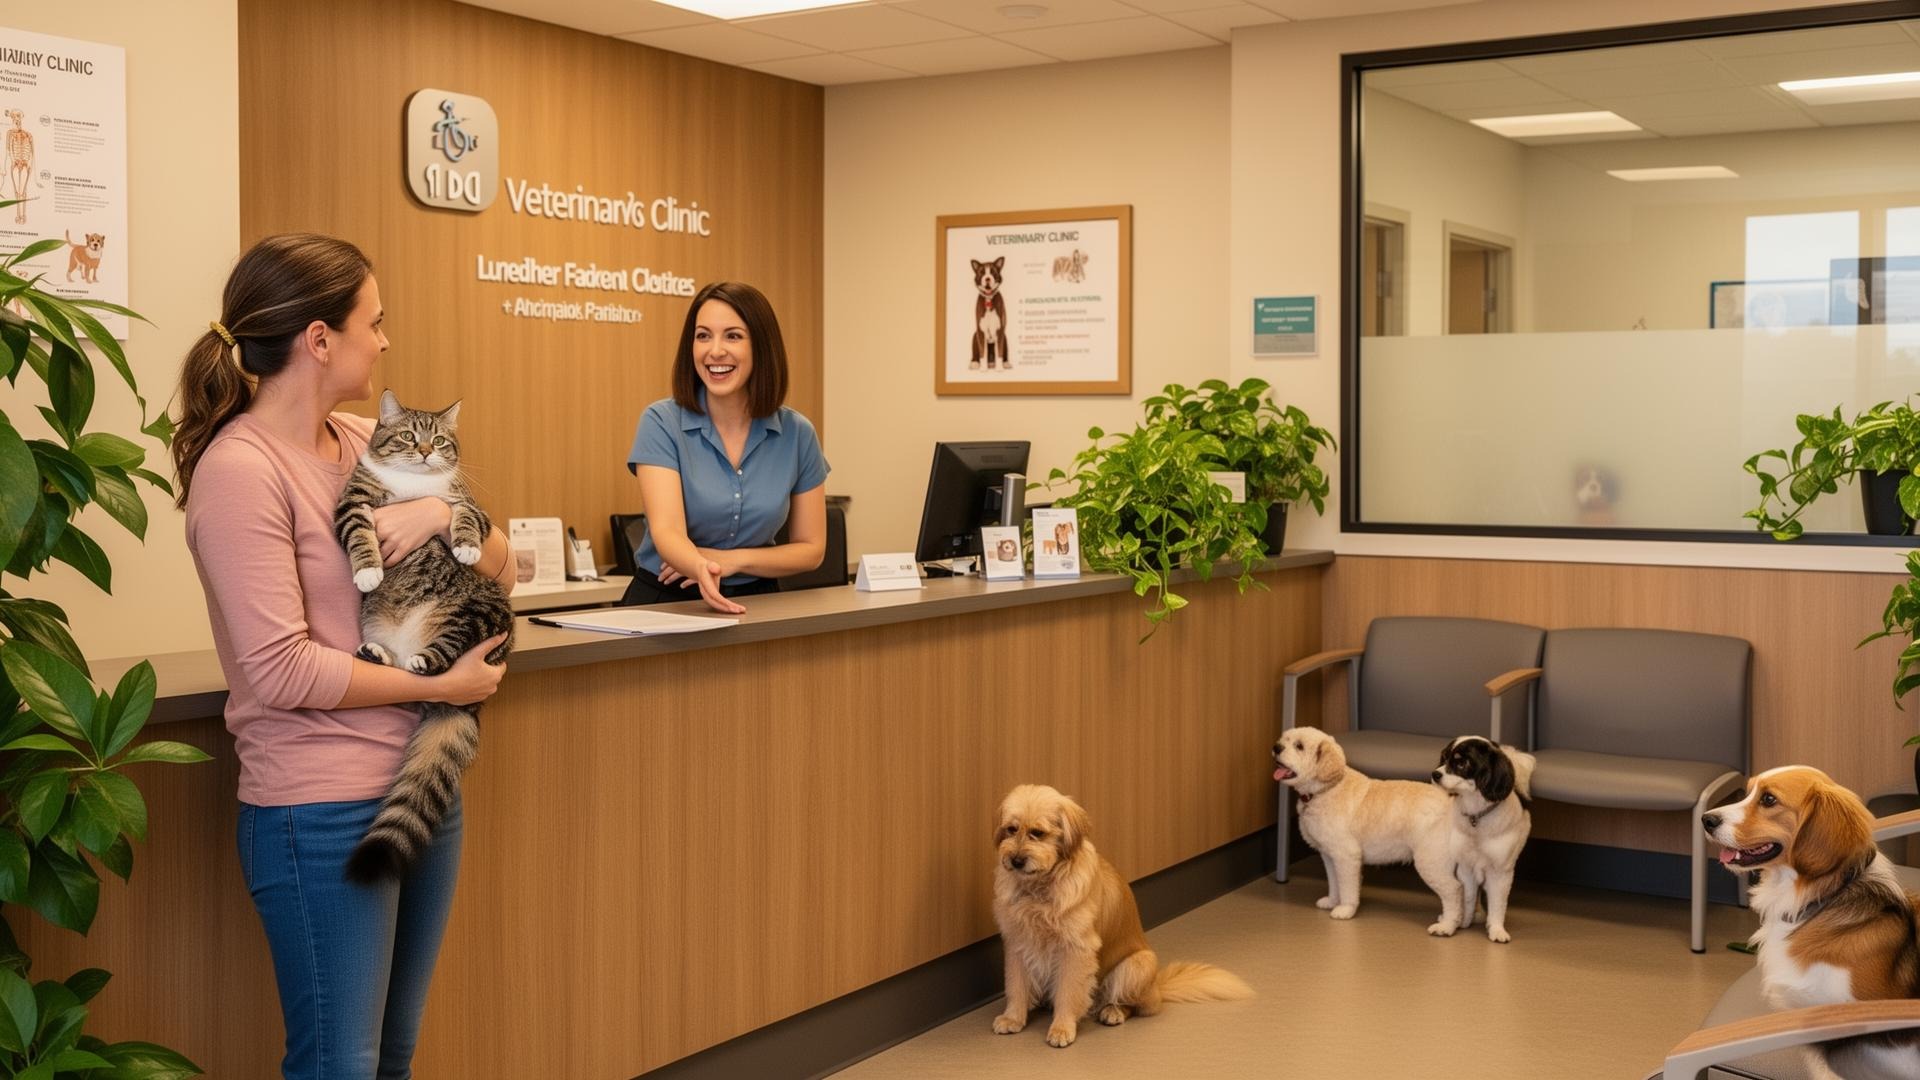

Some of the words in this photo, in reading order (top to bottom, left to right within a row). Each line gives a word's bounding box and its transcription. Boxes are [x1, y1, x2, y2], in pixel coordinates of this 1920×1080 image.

[47, 55, 93, 76] CLINIC
[651, 196, 711, 236] Clinic
[1048, 231, 1080, 243] CLINIC
